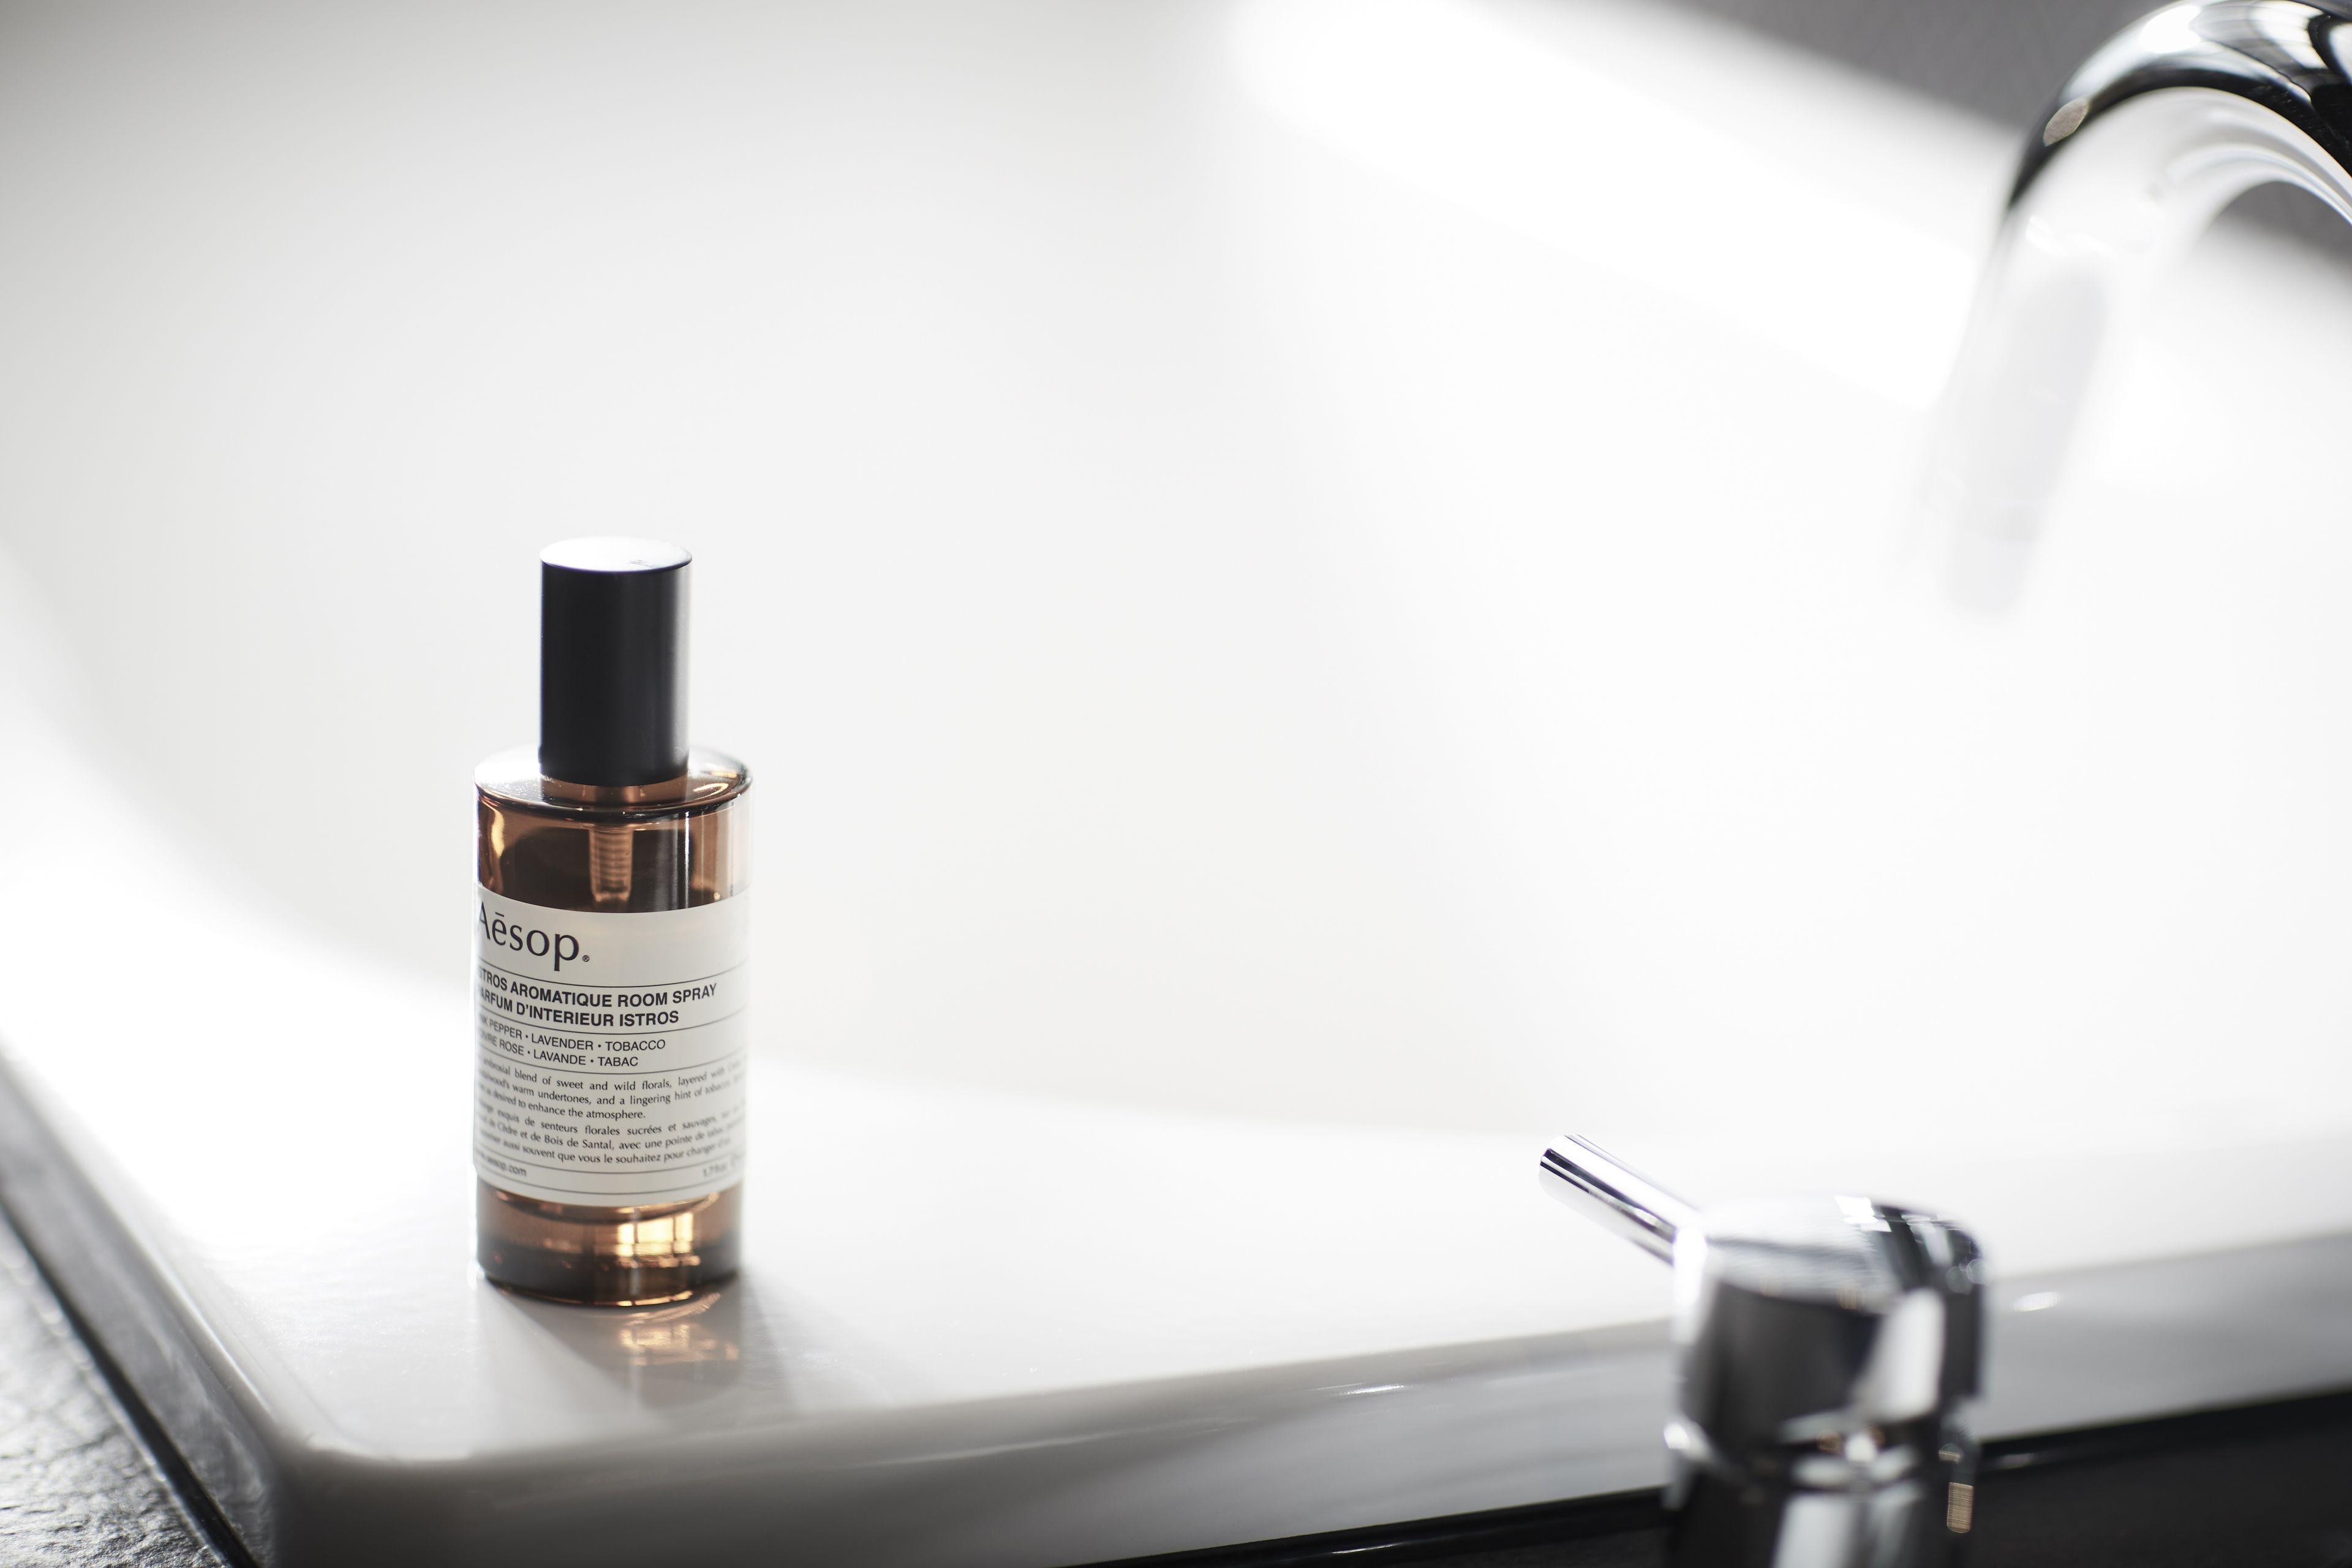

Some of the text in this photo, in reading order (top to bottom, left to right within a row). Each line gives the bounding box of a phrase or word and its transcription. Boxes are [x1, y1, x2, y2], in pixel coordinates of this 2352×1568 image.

[479, 966, 717, 1008] STROS AROMATIQUE ROOM SPRAY
[480, 987, 679, 1027] ARFUM D'INTERIEUR ISTROS
[489, 1019, 522, 1039] PEPPER
[532, 1033, 593, 1050] LAVENDER
[605, 1039, 666, 1051] TOBACCO
[499, 1039, 524, 1056] ROSE
[533, 1049, 586, 1066] LAVANDE
[598, 1057, 638, 1066] TABAC
[514, 1068, 537, 1082] blend
[542, 1076, 551, 1085] of
[556, 1080, 583, 1089] sweet
[589, 1081, 608, 1090] and
[614, 1081, 635, 1090] wild
[642, 1079, 672, 1090] florals,
[678, 1071, 707, 1087] layered
[513, 1084, 534, 1096] warm
[538, 1090, 592, 1105] undertones,
[597, 1095, 615, 1104] and
[630, 1093, 671, 1106] lingering
[674, 1091, 691, 1101] hint
[694, 1087, 703, 1097] of
[518, 1098, 526, 1109] to
[528, 1102, 565, 1115] enhance
[568, 1107, 583, 1118] the
[586, 1110, 646, 1121] atmosphere.
[524, 1117, 535, 1126] de
[541, 1121, 578, 1133] senteurs
[585, 1125, 620, 1135] florales
[627, 1125, 662, 1135] sucrées
[668, 1123, 676, 1133] et
[520, 1131, 528, 1139] et
[530, 1132, 541, 1142] de
[544, 1134, 564, 1145] Bois
[567, 1137, 579, 1147] de
[582, 1139, 615, 1150] Santal,
[645, 1140, 662, 1148] une
[665, 1135, 693, 1148] pointe
[522, 1145, 555, 1159] souvent
[557, 1152, 576, 1163] que
[578, 1155, 601, 1163] vous
[604, 1153, 612, 1163] le
[616, 1153, 661, 1164] souhaitez
[664, 1150, 684, 1163] pour
